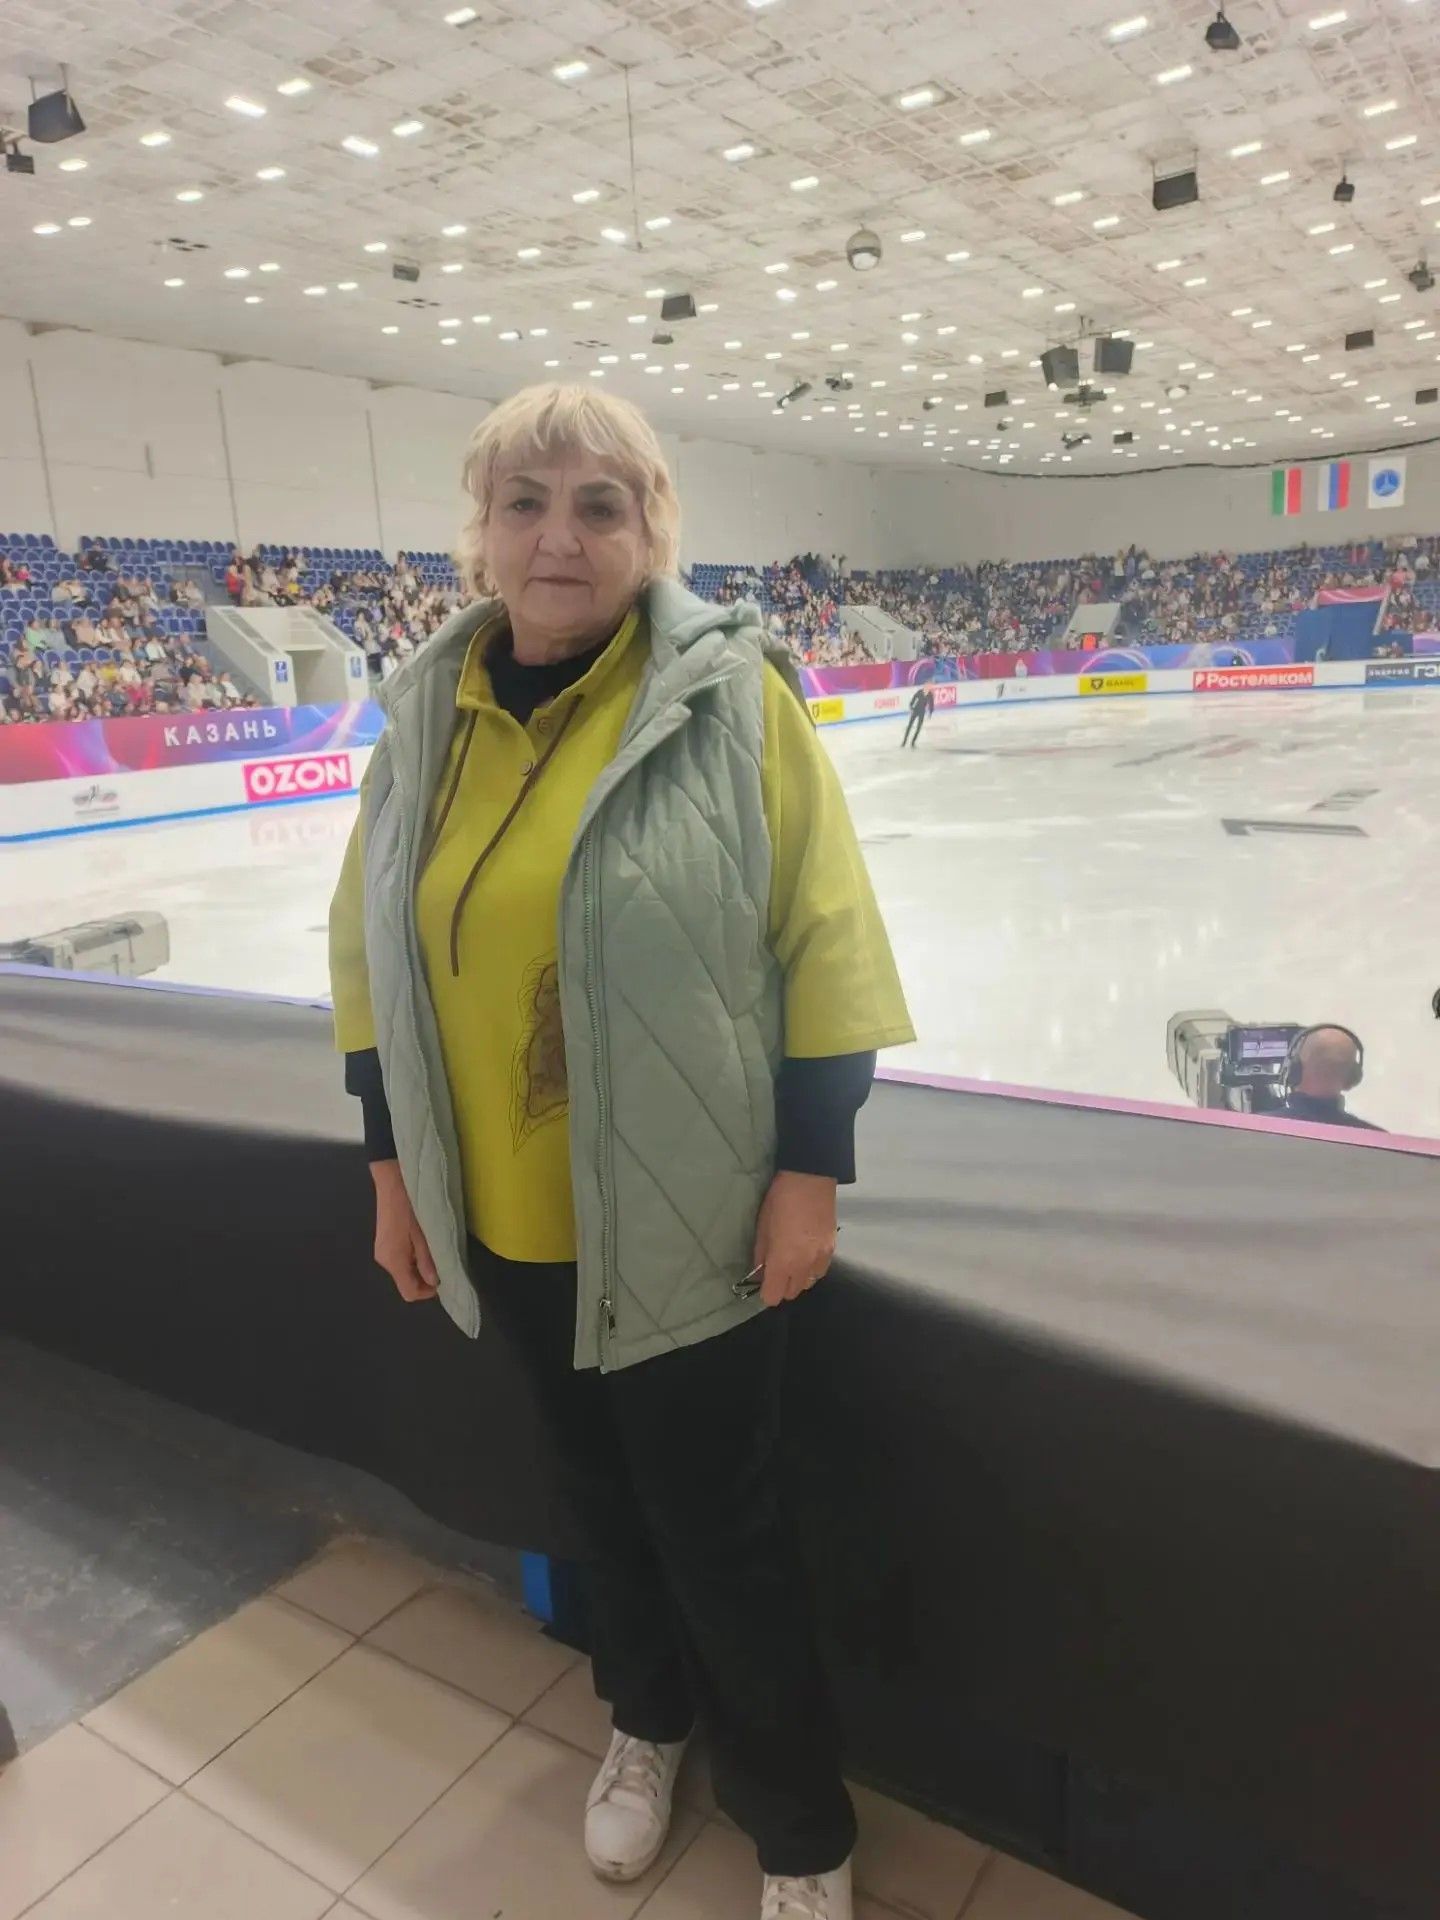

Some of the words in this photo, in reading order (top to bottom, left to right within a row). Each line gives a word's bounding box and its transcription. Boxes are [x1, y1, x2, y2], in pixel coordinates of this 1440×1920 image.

[1206, 672, 1313, 689] Ростелеком
[163, 719, 277, 747] КАЗАНЬ
[250, 759, 348, 796] OZON
